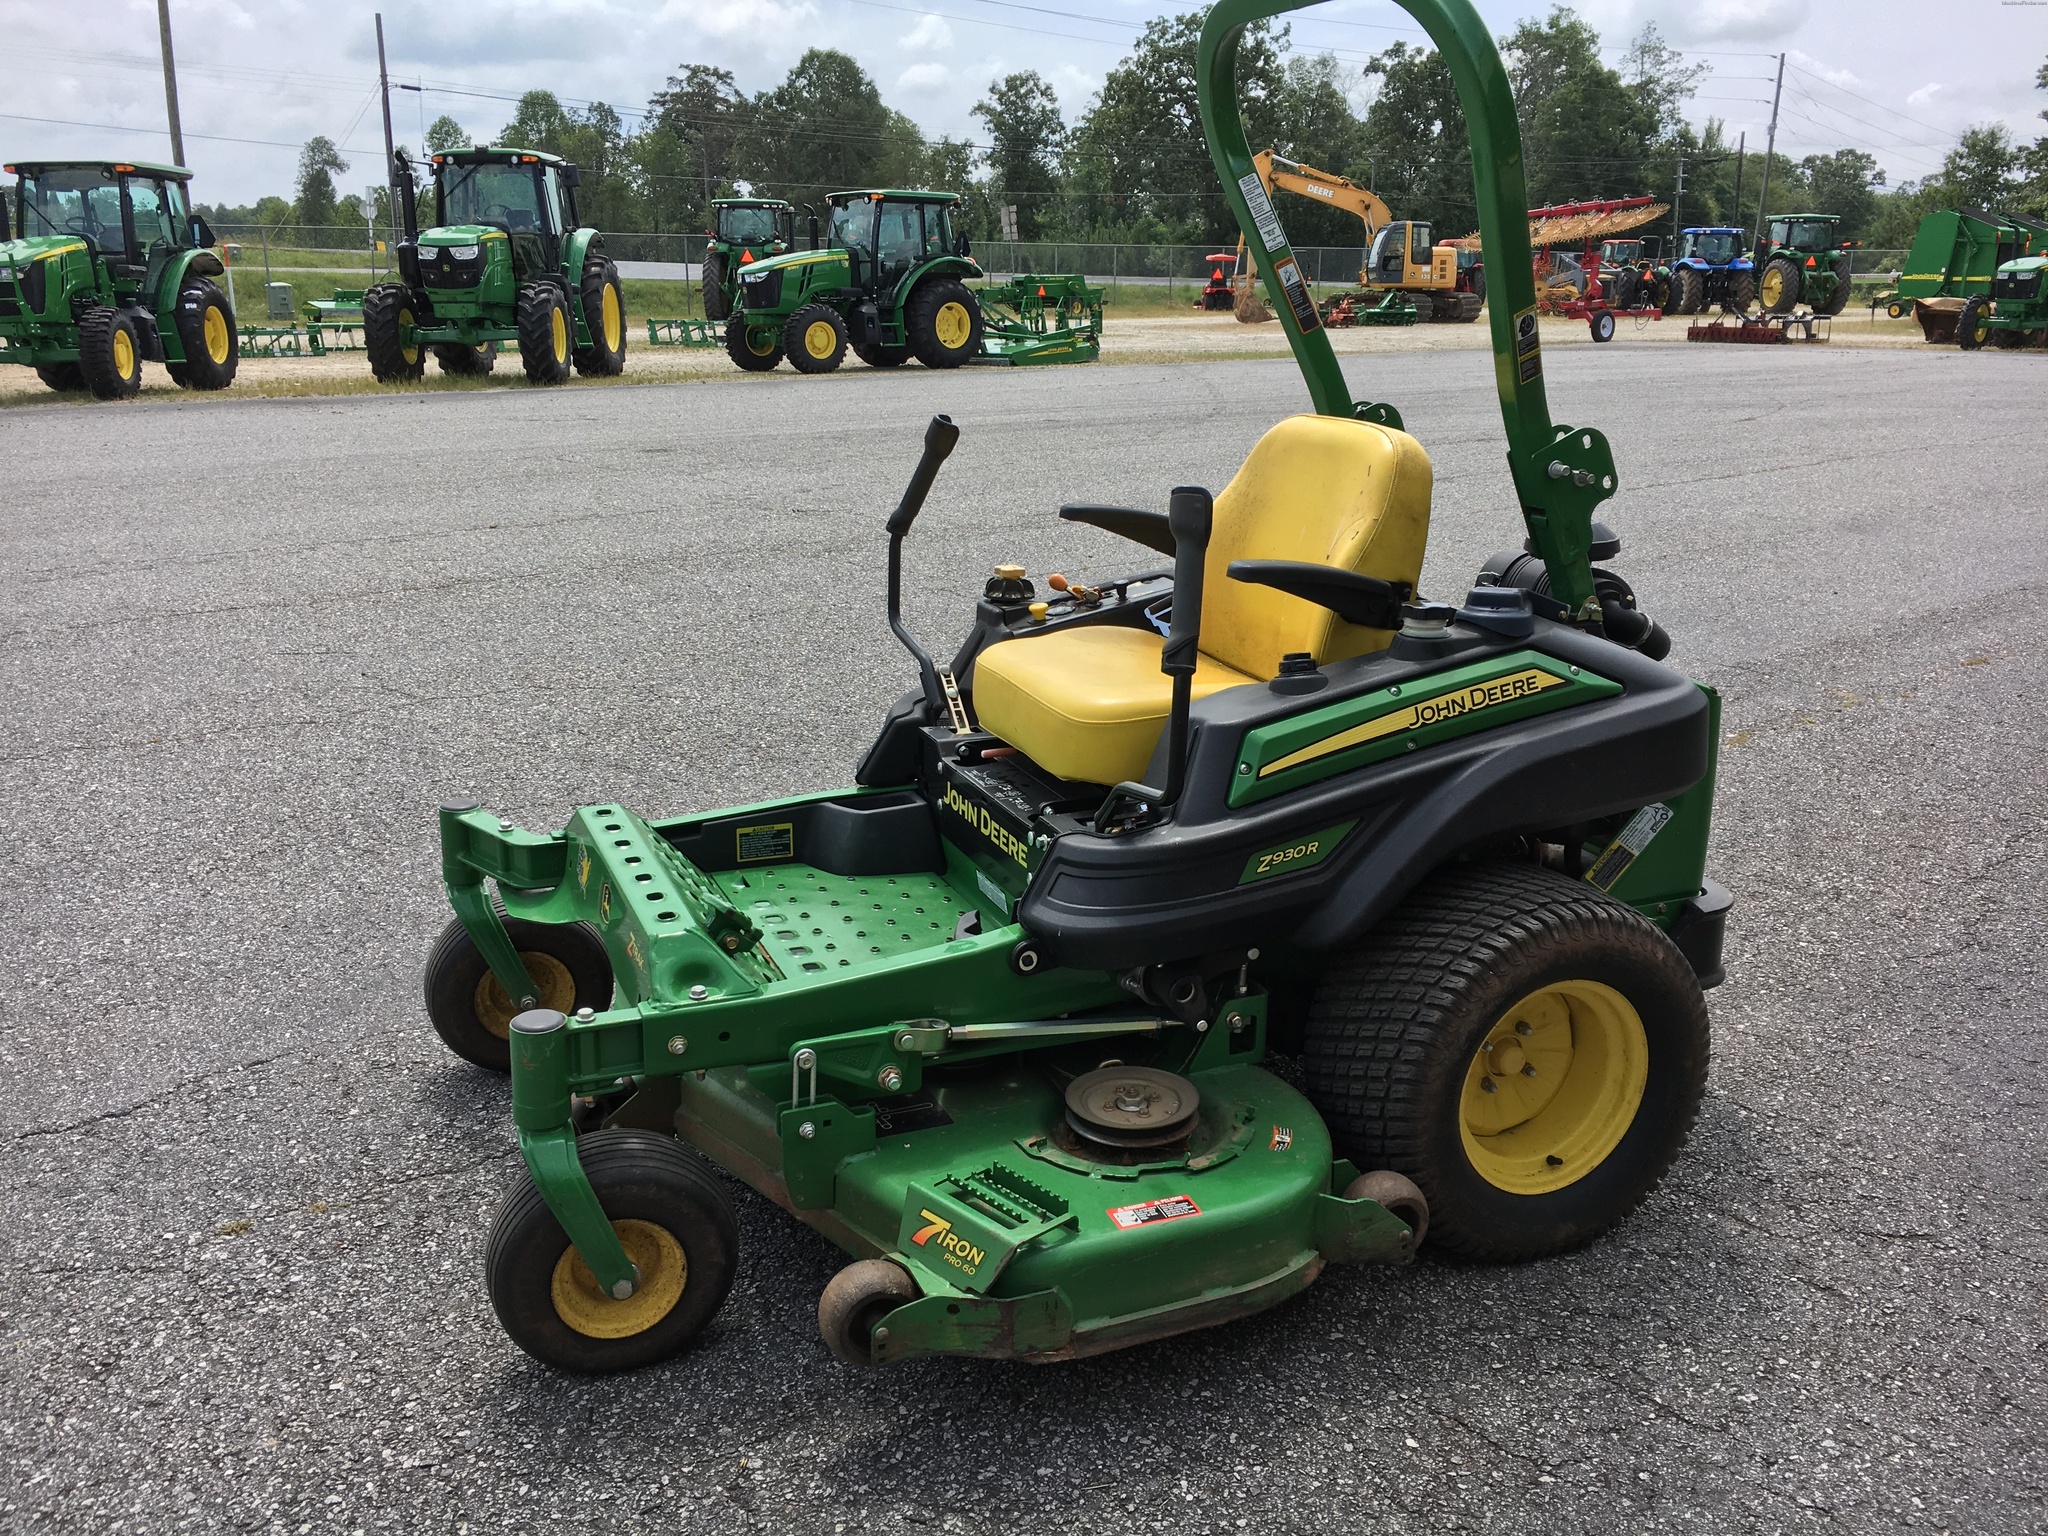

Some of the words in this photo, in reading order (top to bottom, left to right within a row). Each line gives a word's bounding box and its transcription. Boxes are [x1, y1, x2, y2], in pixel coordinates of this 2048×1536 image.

[1307, 184, 1334, 198] DEERE
[1409, 696, 1468, 729] JOHN
[1470, 675, 1541, 709] DEERE
[943, 781, 978, 828] JOHN
[980, 807, 1028, 869] DEERE
[1256, 841, 1319, 873] Z930R
[943, 1252, 962, 1268] PRO
[962, 1264, 976, 1276] 60
